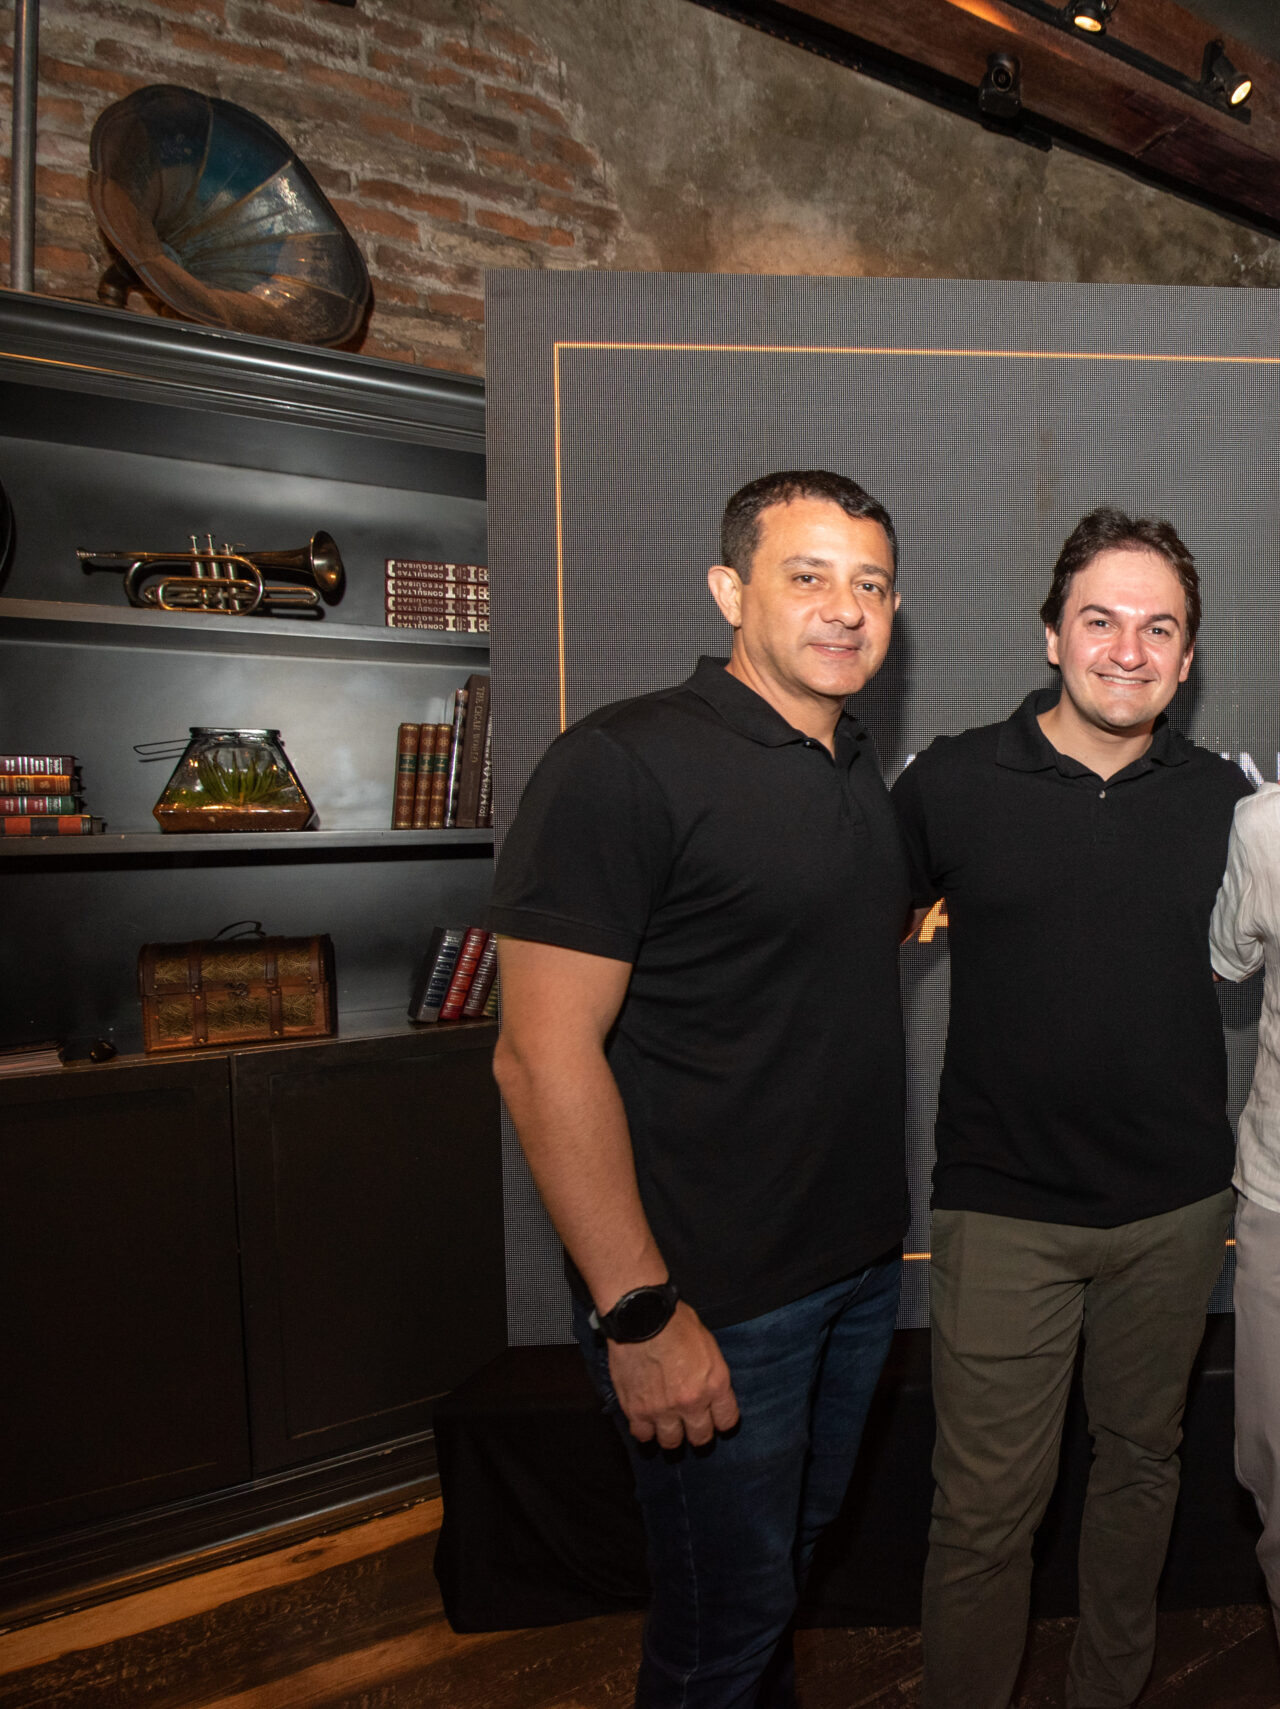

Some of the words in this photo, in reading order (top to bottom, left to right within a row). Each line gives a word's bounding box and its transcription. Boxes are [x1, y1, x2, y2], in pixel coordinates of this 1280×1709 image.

[397, 562, 444, 571] PESQUISAS
[397, 570, 444, 579] CONSULTAS
[397, 580, 444, 589] PESQUISAS
[397, 588, 444, 597] CONSULTAS
[397, 605, 444, 613] CONSULTAS
[397, 613, 444, 622] PESQUISAS
[397, 622, 444, 630] CONSULTAS
[475, 686, 485, 704] THE
[473, 705, 483, 731] CIGAR
